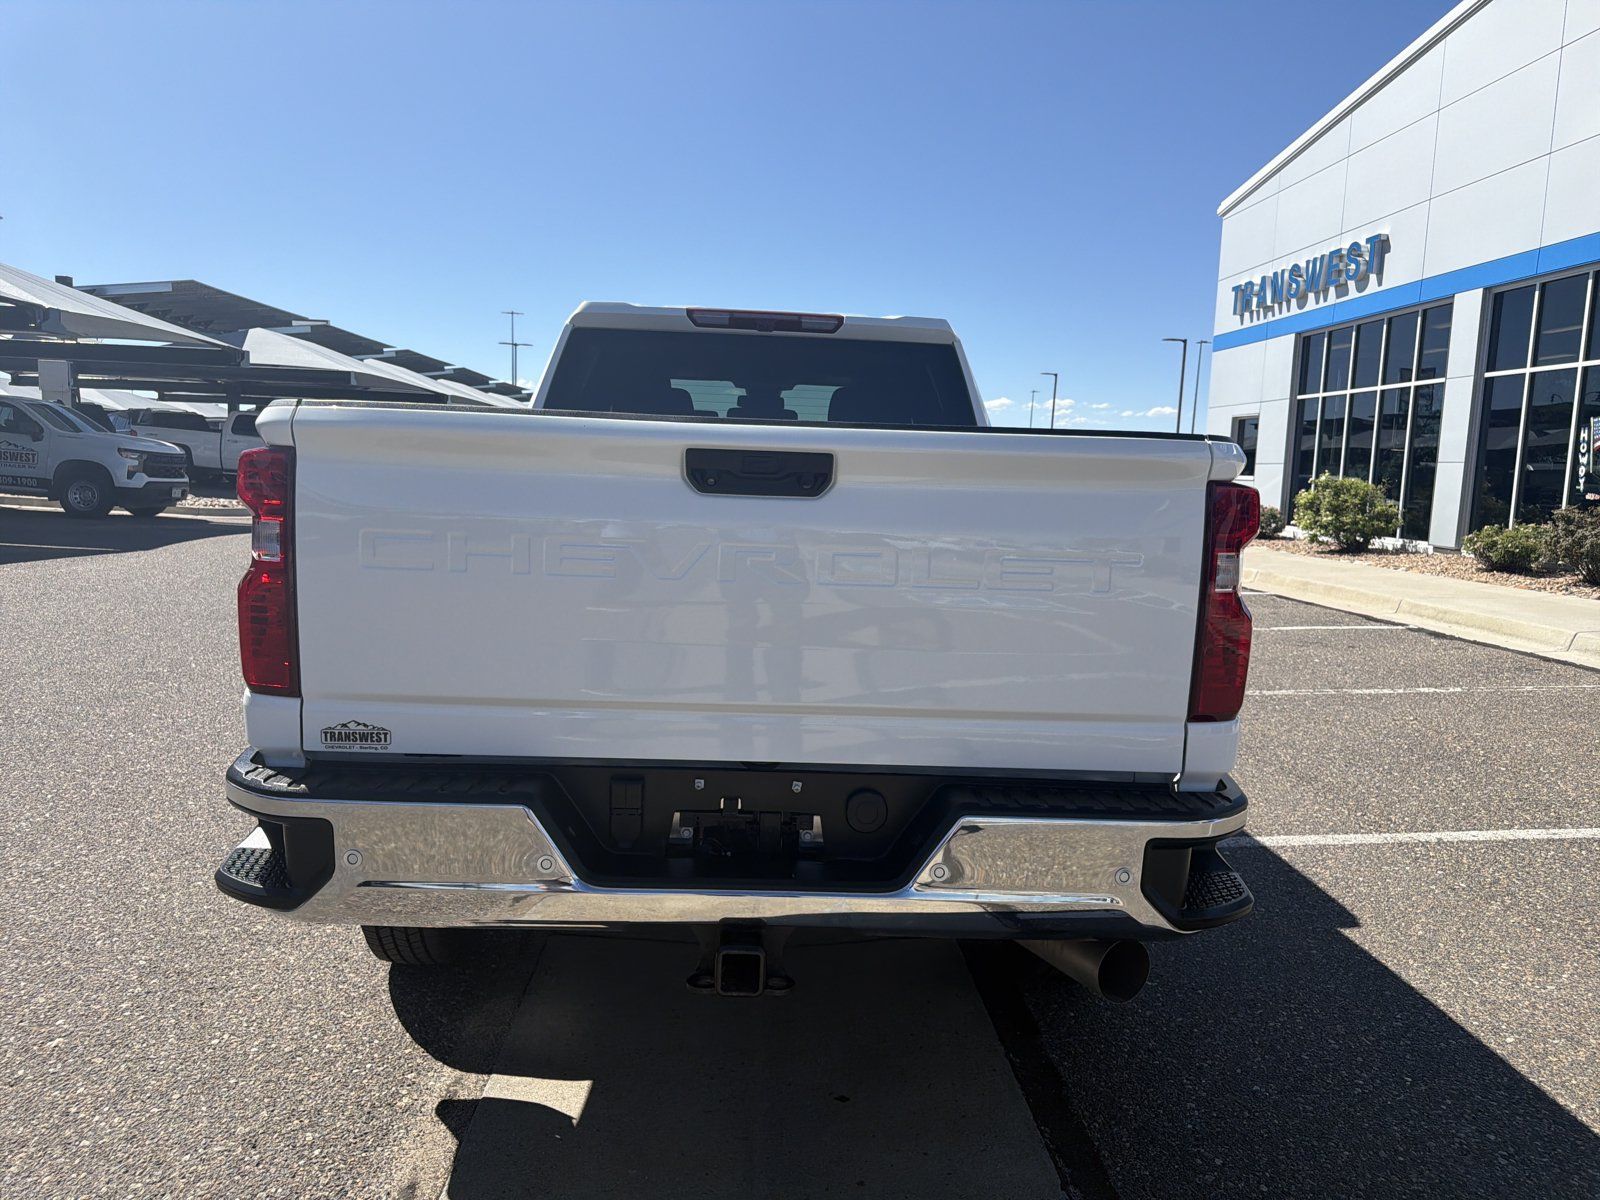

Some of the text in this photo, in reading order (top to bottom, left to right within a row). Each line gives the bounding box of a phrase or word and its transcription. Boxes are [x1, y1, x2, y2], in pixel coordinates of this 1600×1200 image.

[1231, 233, 1388, 316] TRANSWEST
[358, 527, 1145, 594] CHEVROLET
[322, 731, 389, 743] TRANSWEST
